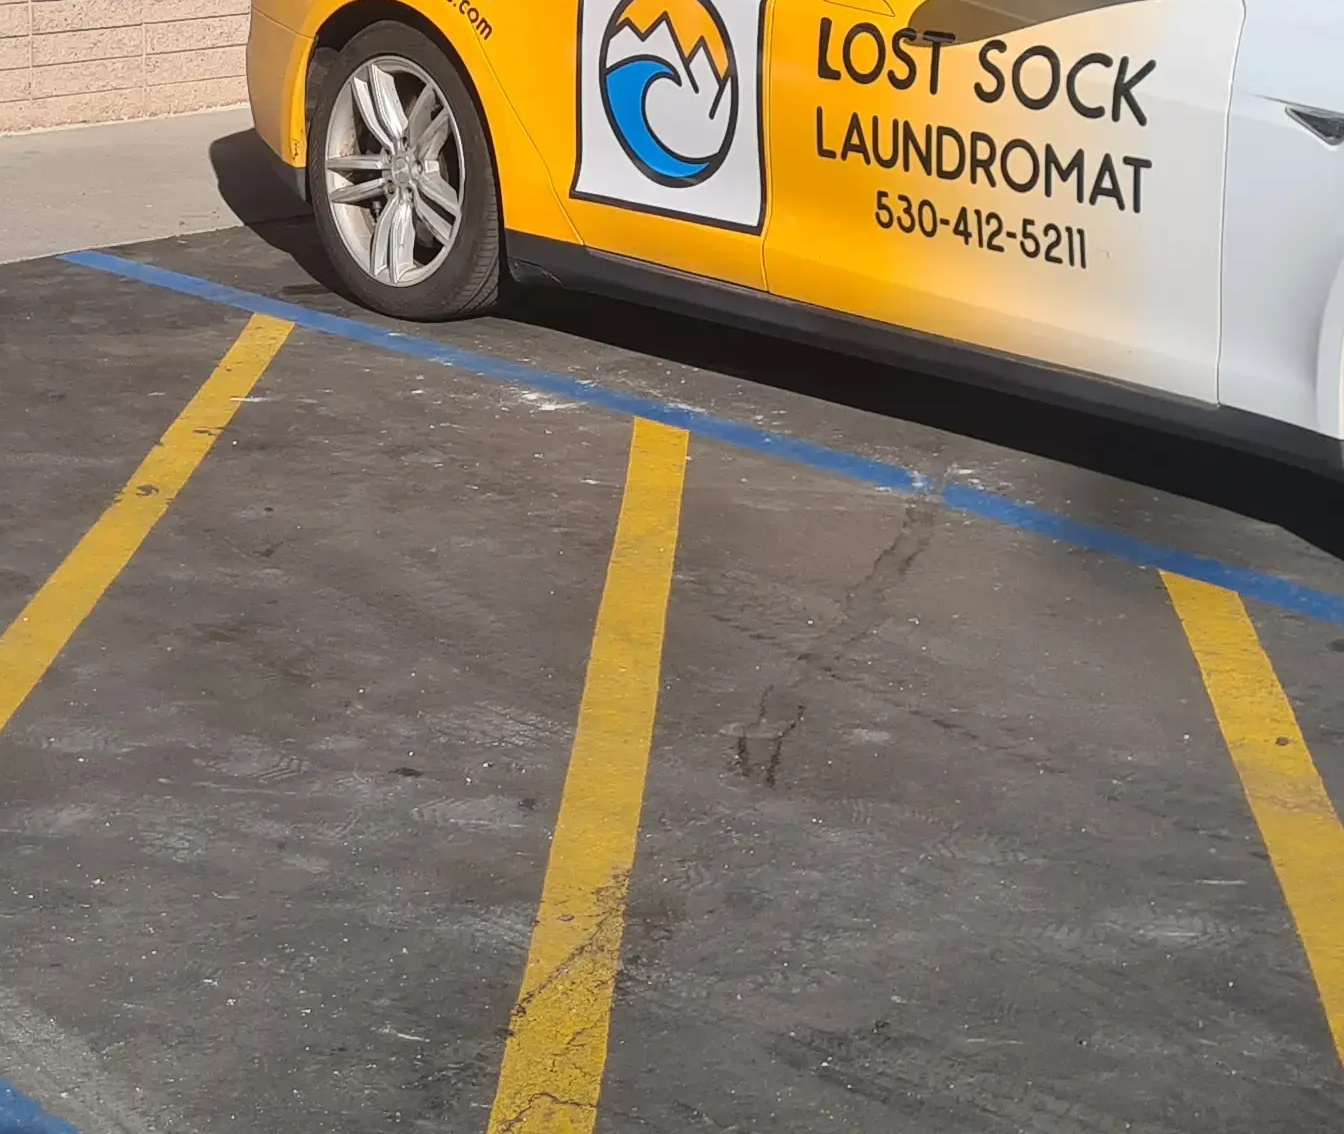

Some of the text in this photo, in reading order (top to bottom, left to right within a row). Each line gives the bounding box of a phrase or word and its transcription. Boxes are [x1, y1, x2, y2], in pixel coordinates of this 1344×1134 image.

[817, 17, 1157, 127] LOST SOCK
[816, 106, 1153, 214] LAUNDROMAT
[875, 190, 1087, 269] 530-412-5211
